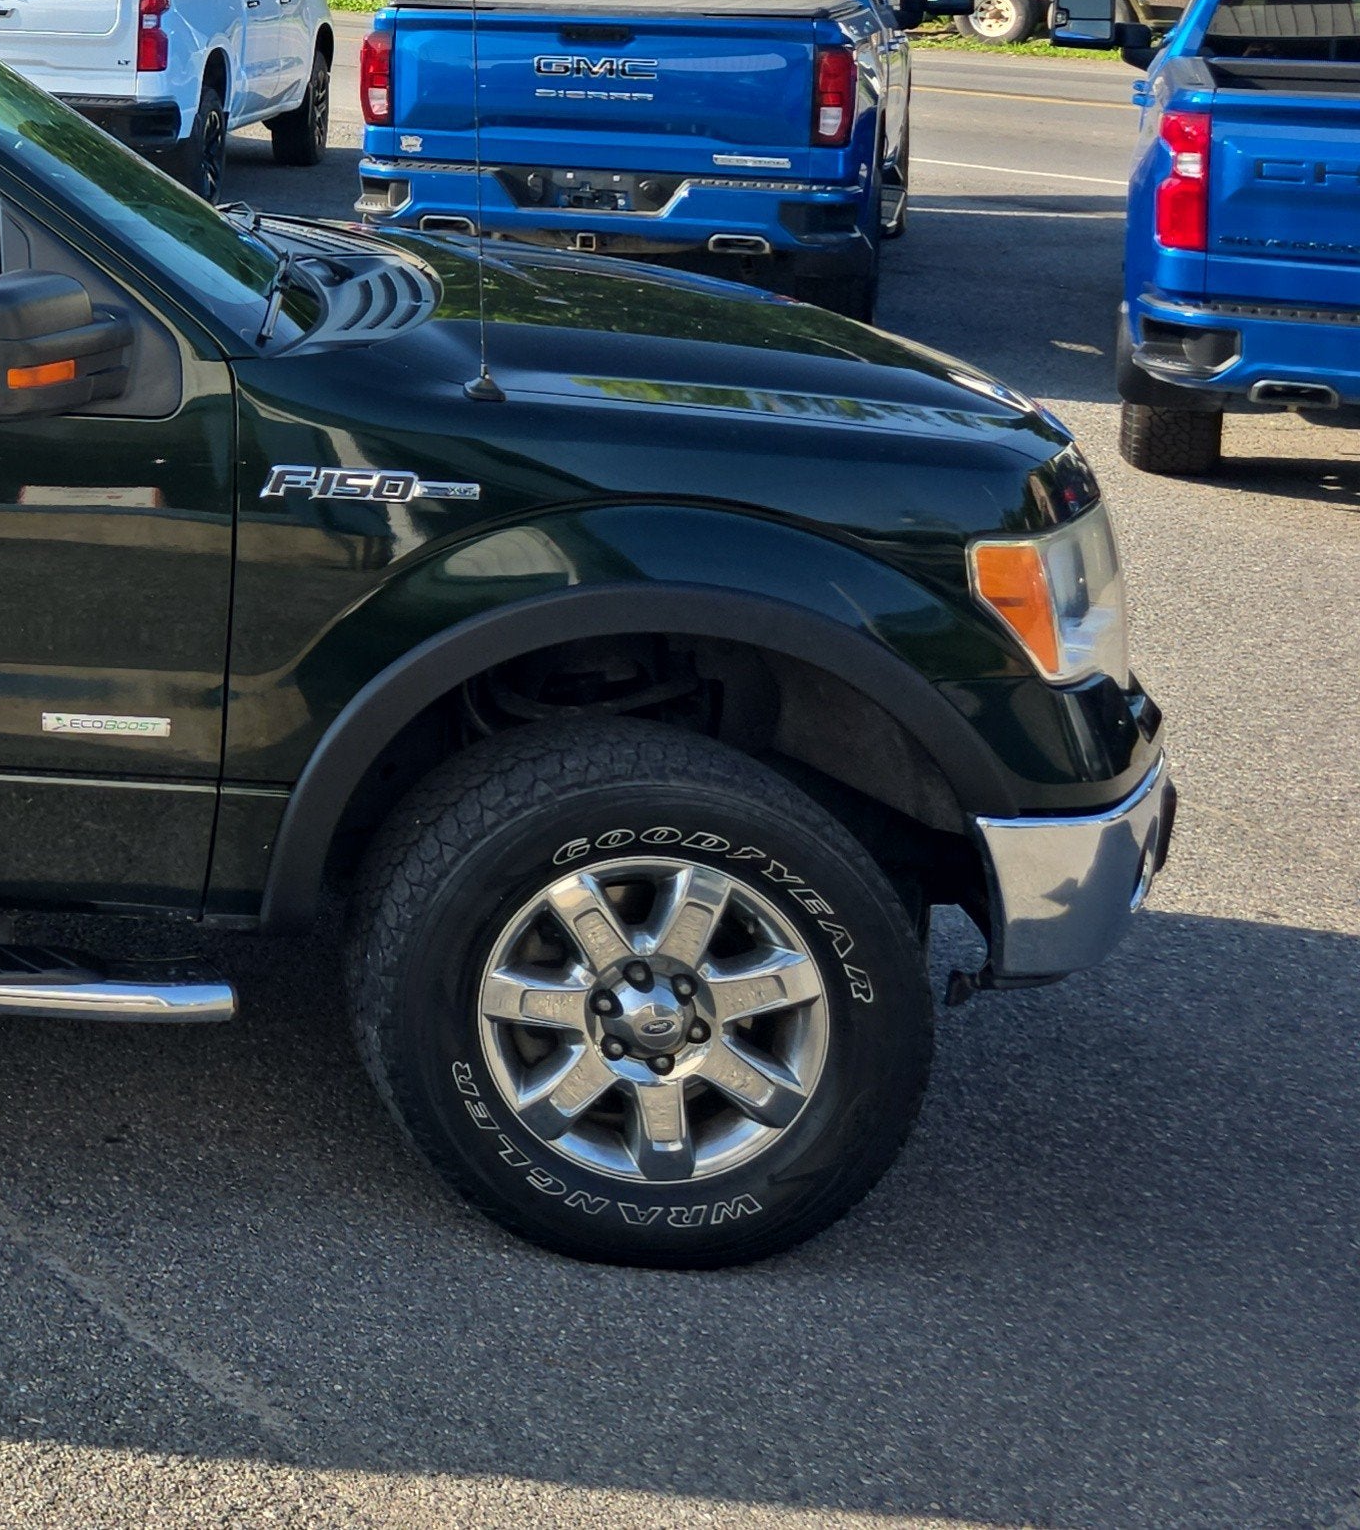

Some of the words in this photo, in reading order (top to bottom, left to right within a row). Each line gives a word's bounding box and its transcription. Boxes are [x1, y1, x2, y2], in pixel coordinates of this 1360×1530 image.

[533, 54, 658, 80] GMC
[534, 88, 654, 101] SIERRA
[1254, 158, 1360, 186] CH
[262, 465, 418, 502] F-150
[69, 718, 161, 732] ECOBOOST
[552, 825, 877, 1005] GOODYEAR
[451, 1060, 763, 1228] WRANGLER
